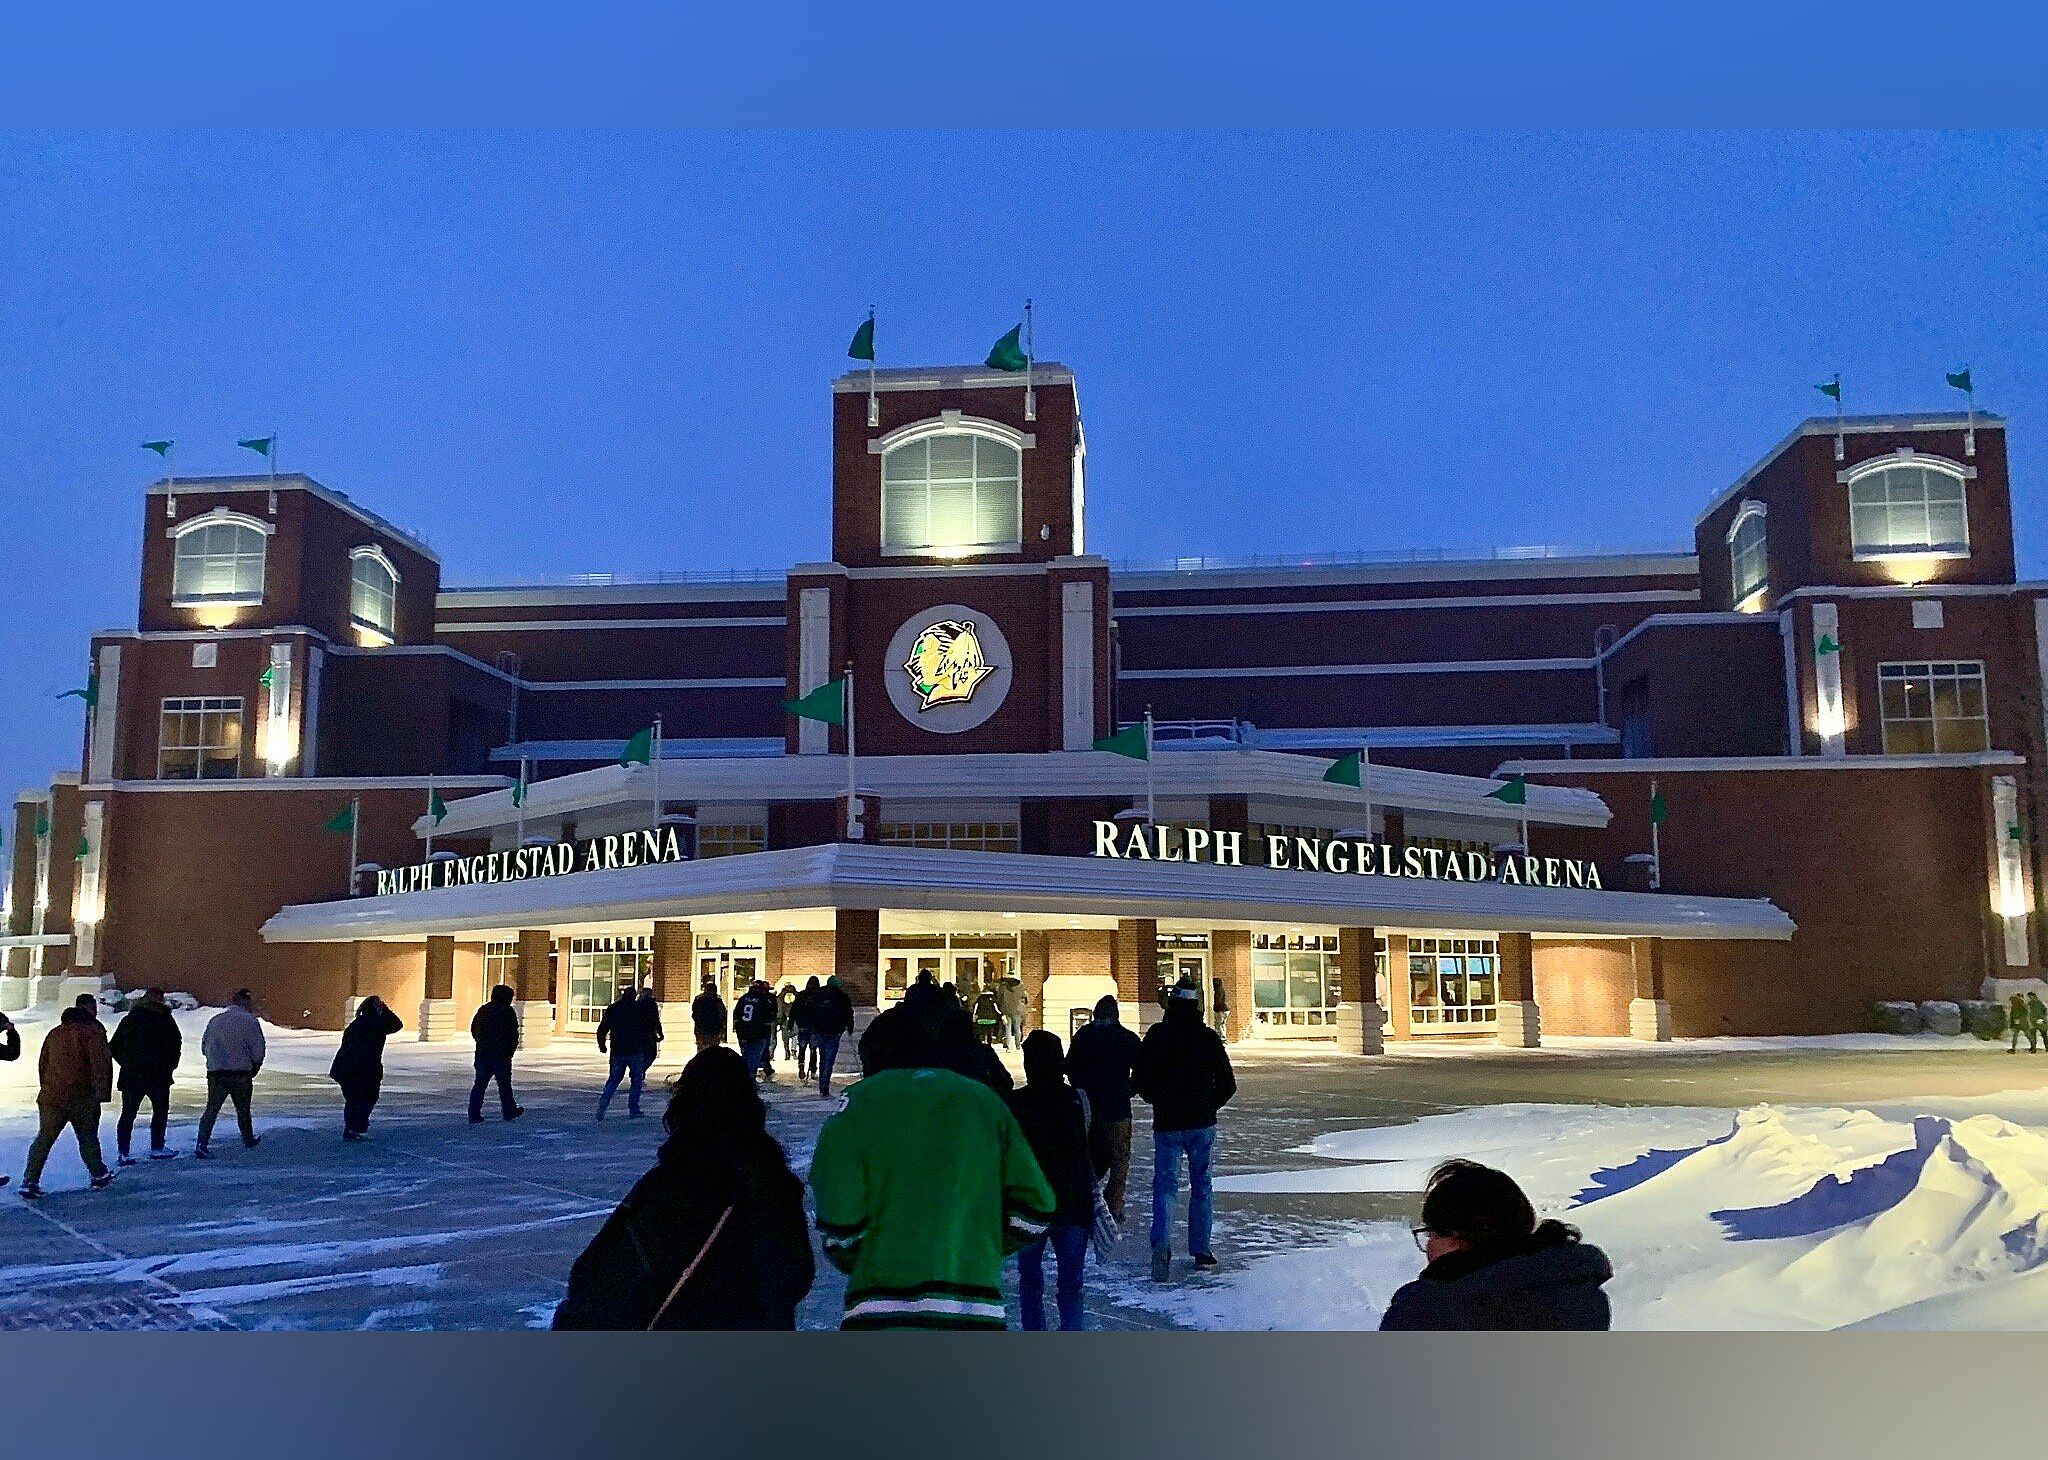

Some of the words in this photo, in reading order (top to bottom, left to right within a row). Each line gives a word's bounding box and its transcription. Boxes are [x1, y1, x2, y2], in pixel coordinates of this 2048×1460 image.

[377, 863, 433, 896] RALPH
[443, 843, 574, 888] ENGELSTAD
[584, 826, 681, 872] ARENA
[1092, 820, 1243, 866] RALPH
[1267, 834, 1487, 882] ENGELSTAD
[1502, 855, 1602, 889] ARENA
[742, 1004, 754, 1022] 9
